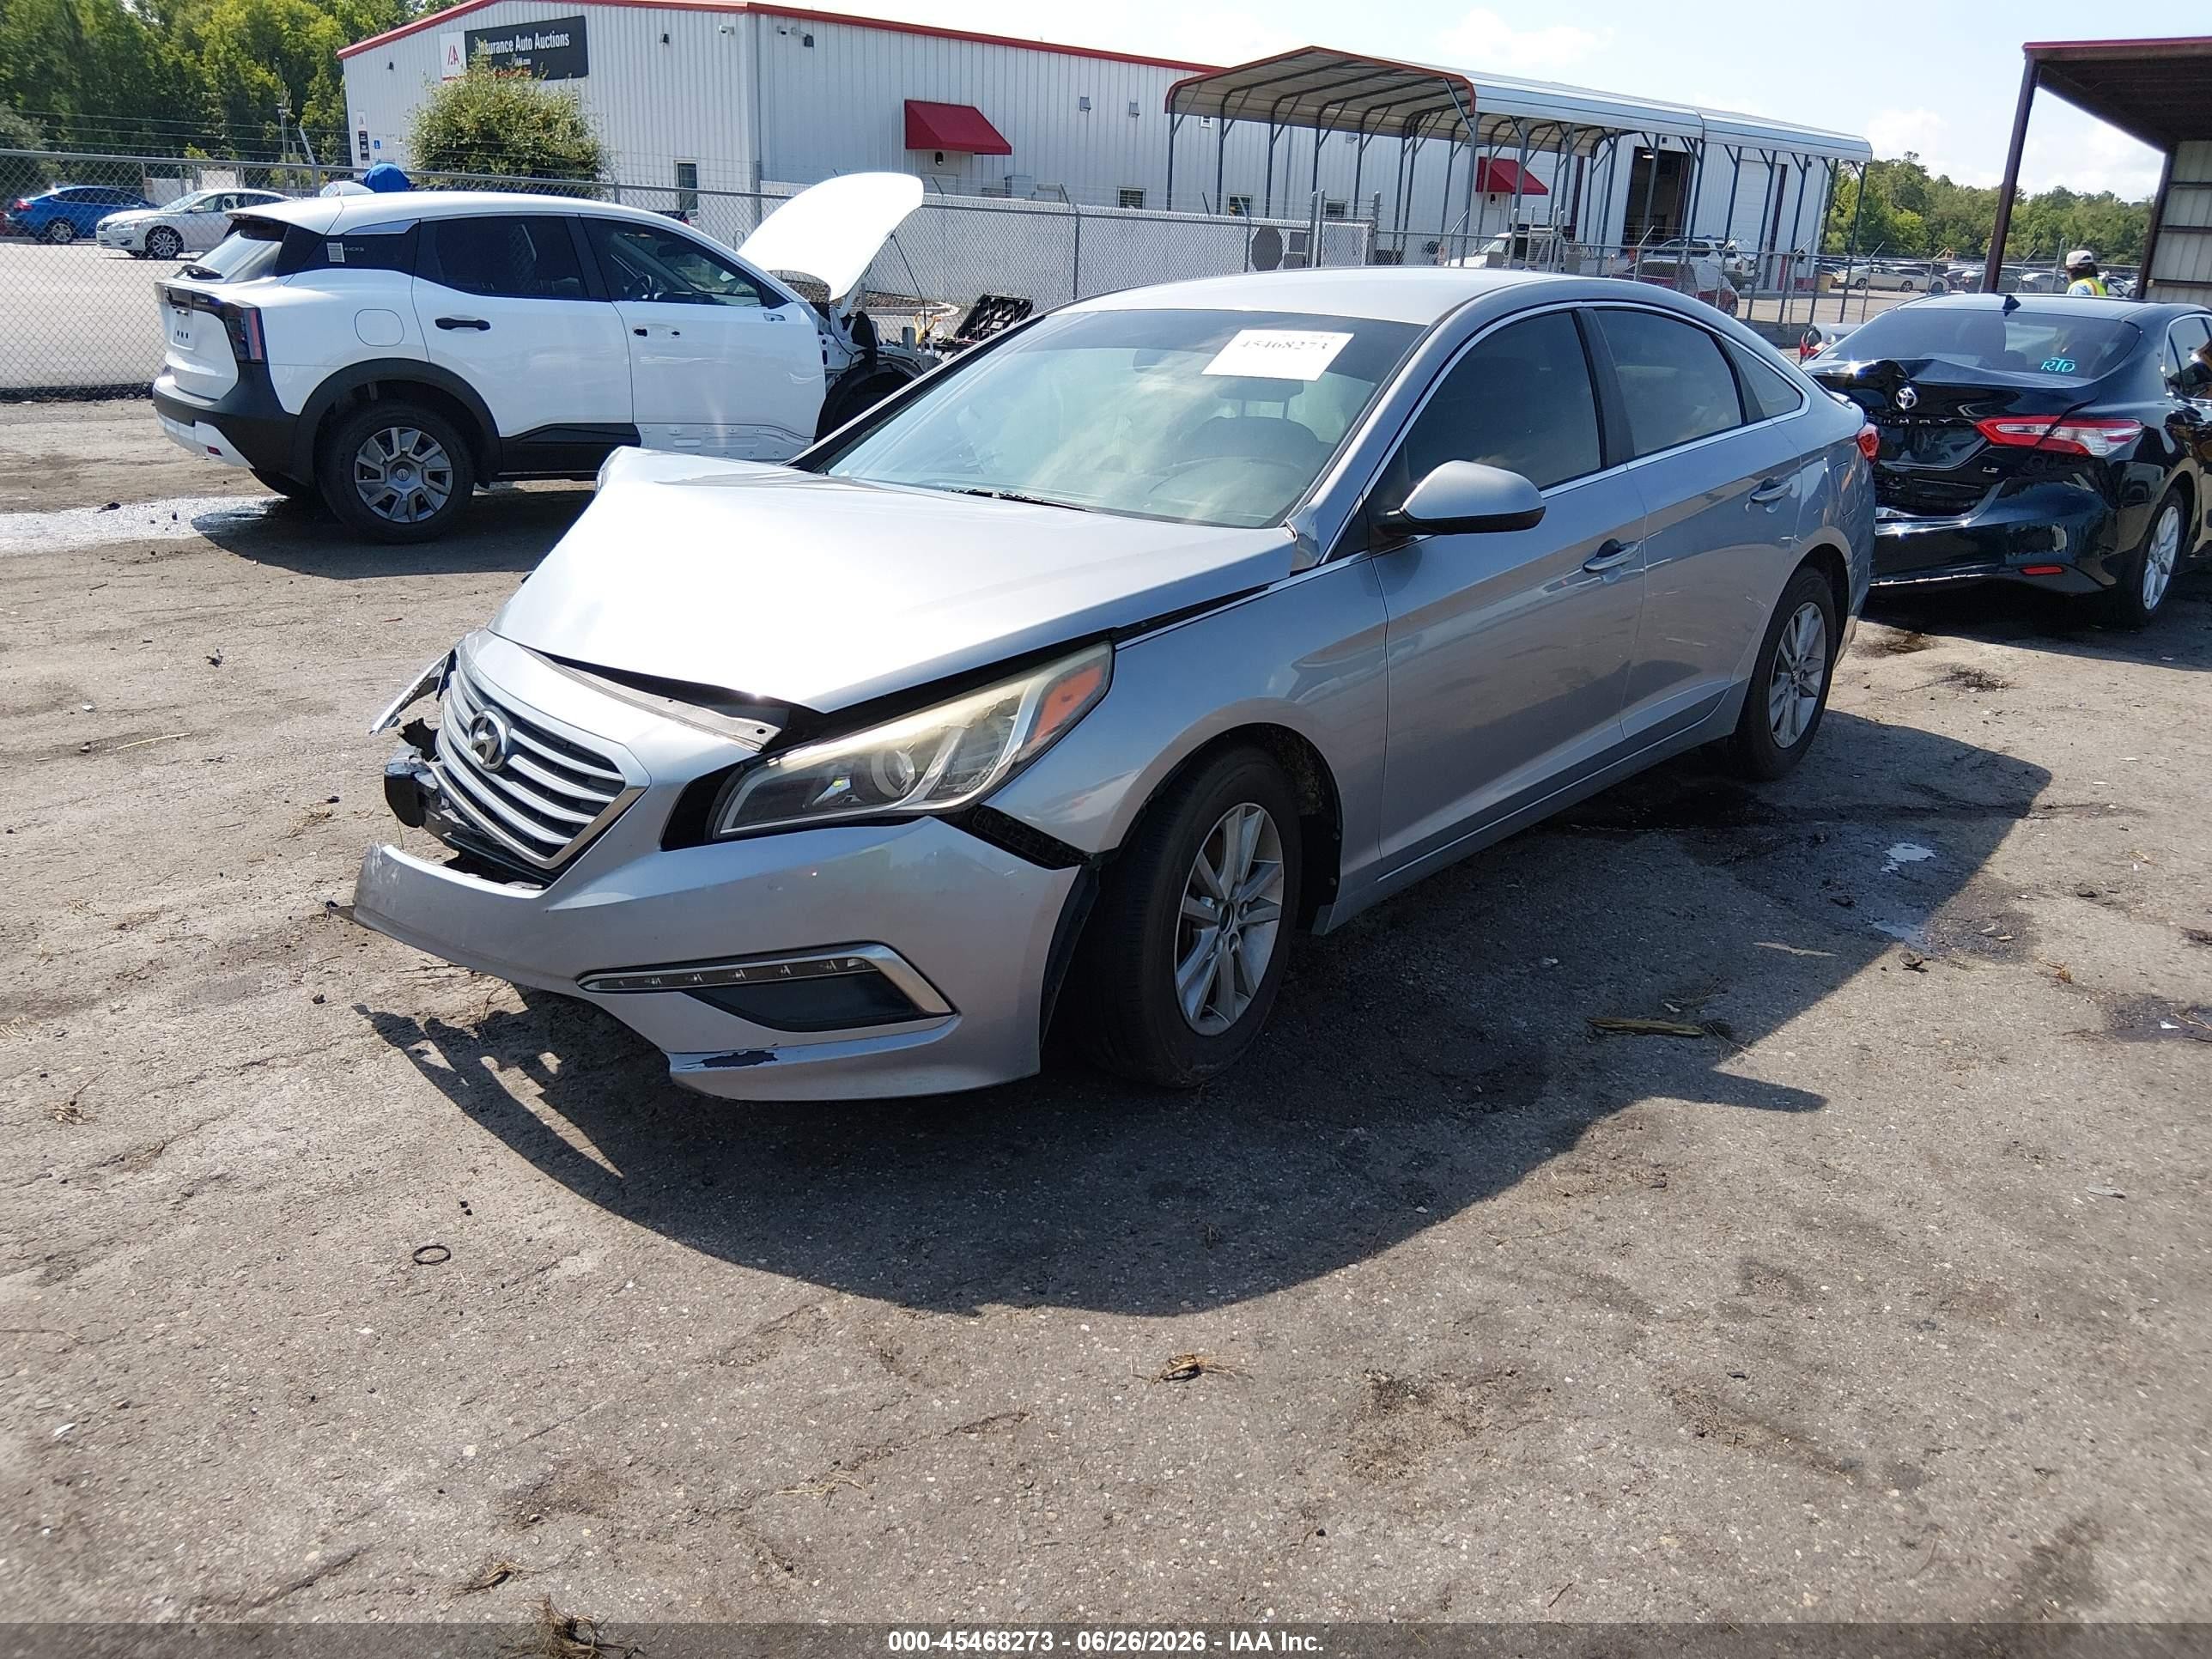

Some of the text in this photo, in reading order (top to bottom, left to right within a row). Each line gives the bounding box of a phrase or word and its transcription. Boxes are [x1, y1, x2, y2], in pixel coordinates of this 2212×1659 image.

[477, 30, 570, 56] Insurance Auto Auctions
